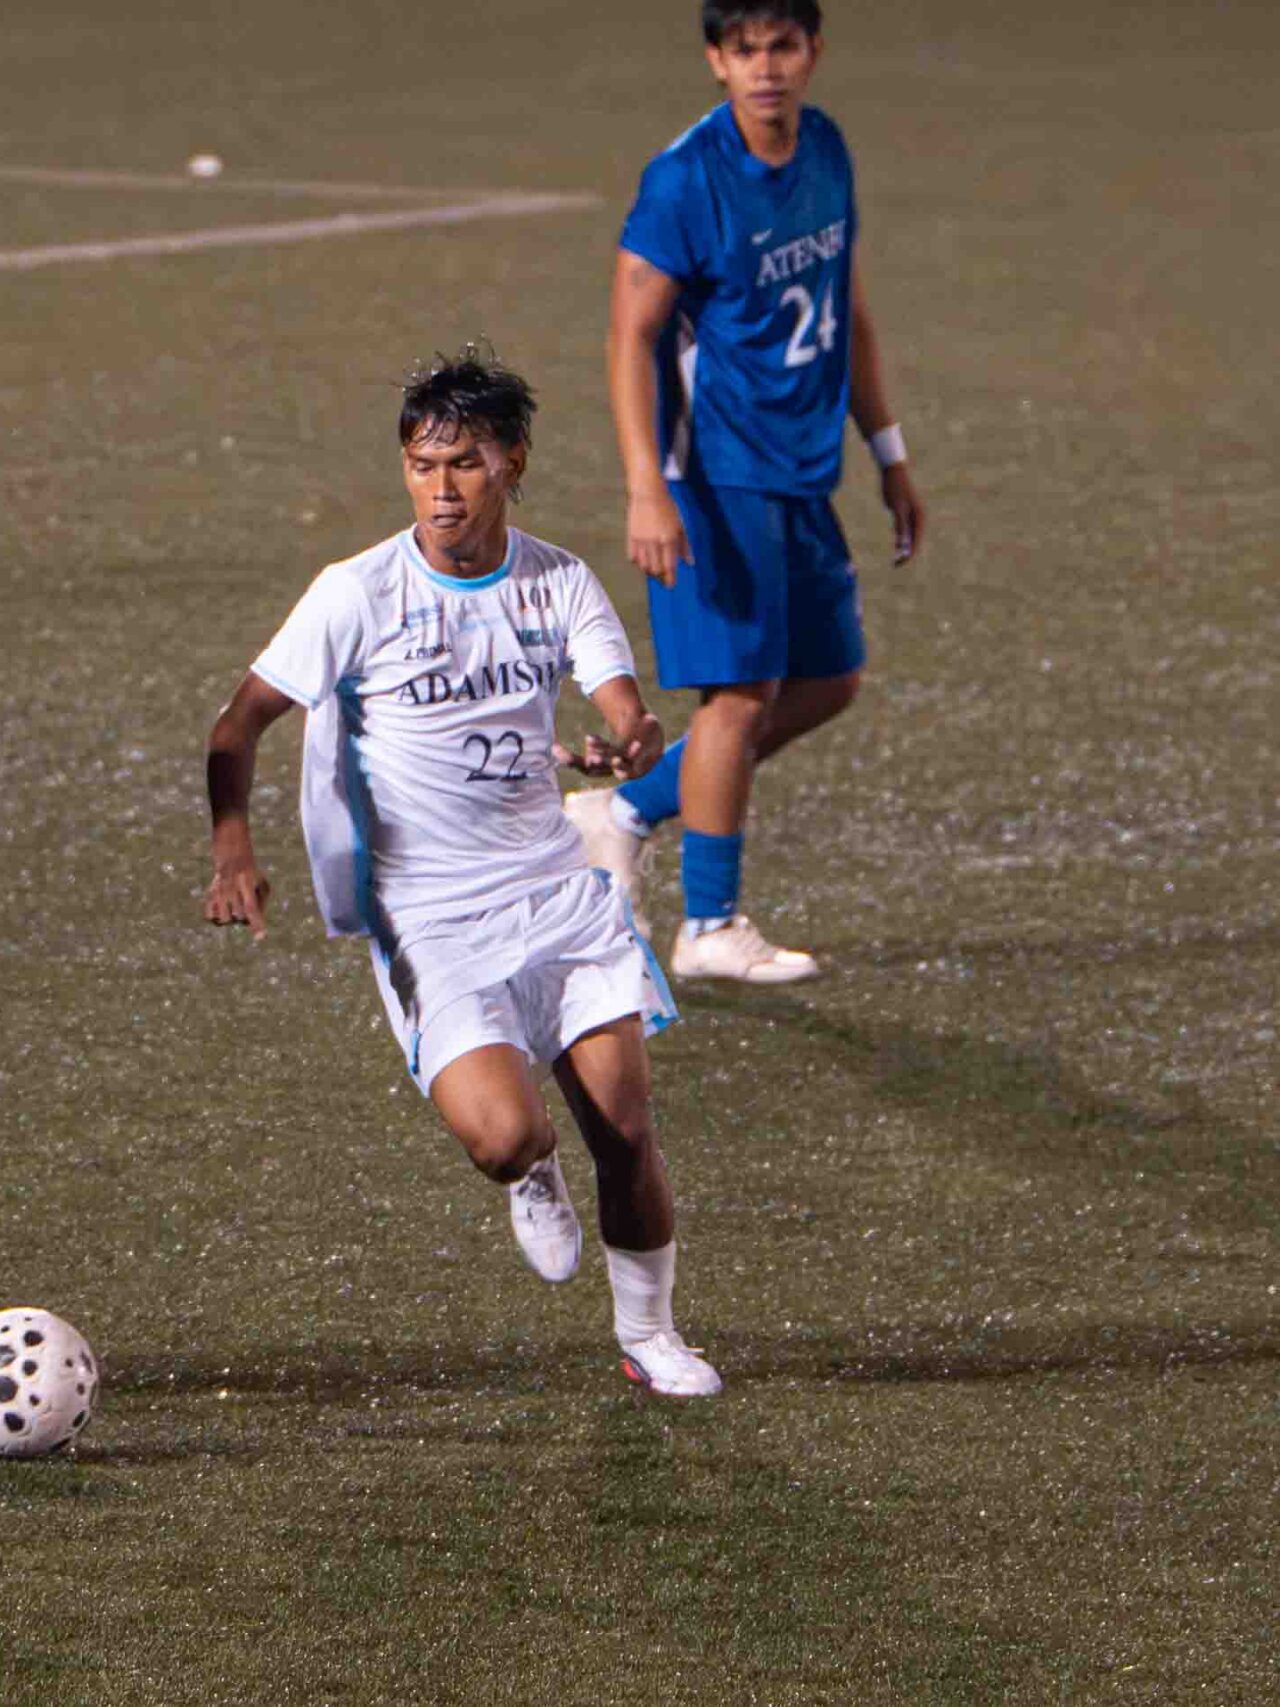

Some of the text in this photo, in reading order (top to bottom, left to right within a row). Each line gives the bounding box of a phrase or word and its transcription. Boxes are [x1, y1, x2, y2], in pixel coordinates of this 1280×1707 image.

[756, 218, 846, 287] ATENE
[779, 278, 838, 368] 24
[463, 730, 527, 783] 22
